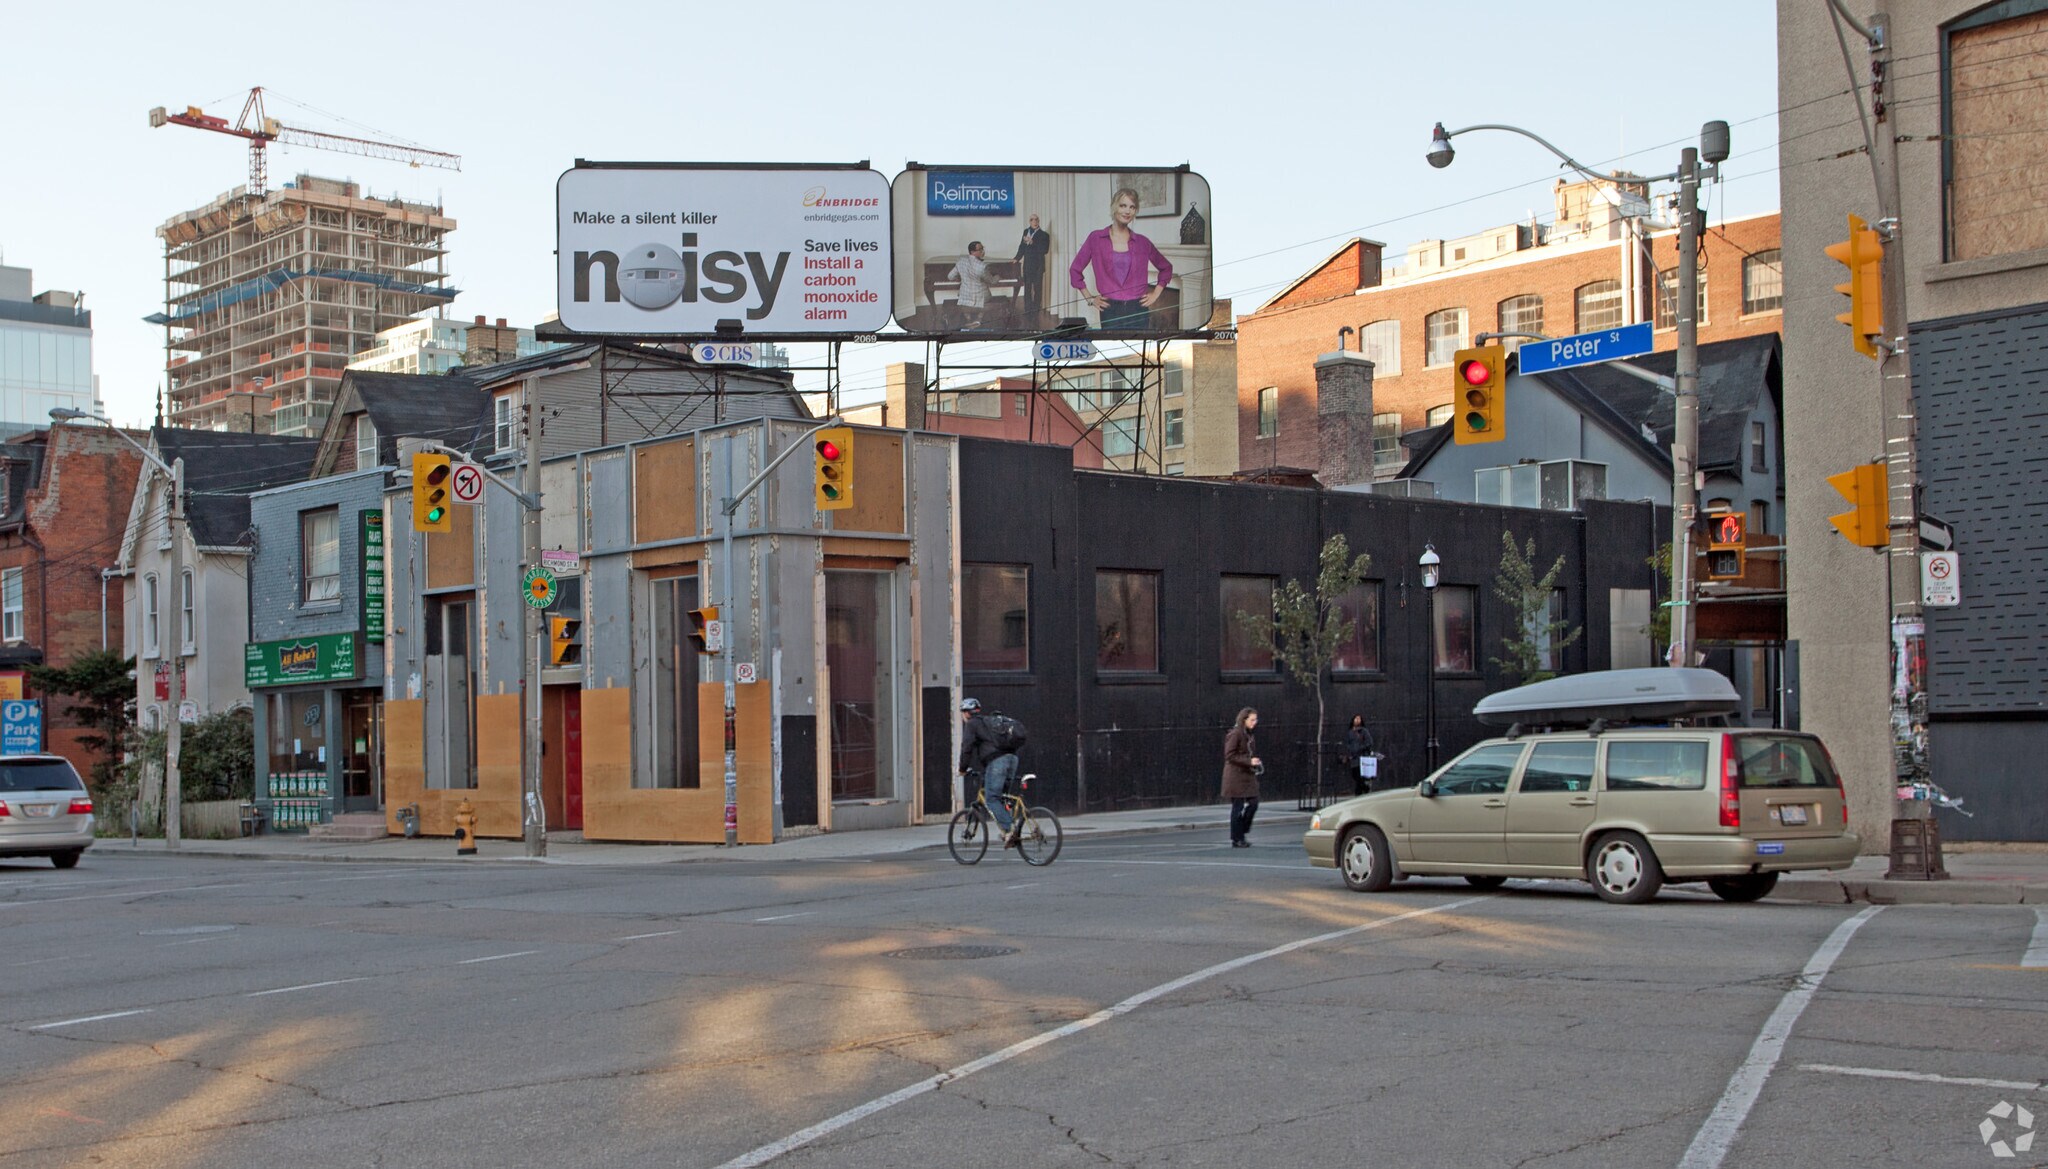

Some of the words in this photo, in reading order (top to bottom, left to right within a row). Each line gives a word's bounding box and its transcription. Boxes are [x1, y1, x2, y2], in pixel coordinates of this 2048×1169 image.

[934, 181, 1008, 201] Reitmans
[815, 198, 879, 207] ENBRIDGE
[943, 203, 969, 211] Designed
[573, 211, 616, 225] Make
[621, 214, 630, 225] a
[635, 211, 676, 225] silent
[681, 211, 718, 225] killer
[804, 213, 879, 223] enbridgegas.com
[804, 239, 842, 252] Save
[844, 239, 879, 252] lives
[804, 256, 851, 270] Install
[854, 259, 863, 270] a
[804, 273, 856, 287] carbon
[804, 290, 878, 303] monoxide
[804, 307, 847, 320] alarm
[853, 334, 877, 344] 2069
[1214, 331, 1236, 340] 2070
[1057, 344, 1090, 360] CBS
[1551, 338, 1601, 362] Peter
[1610, 331, 1620, 343] St
[718, 346, 753, 361] CBS
[543, 559, 566, 567] RICHMOND
[525, 568, 555, 584] GARDINER
[523, 589, 557, 608] EXPRESSWAY
[4, 723, 39, 736] Park
